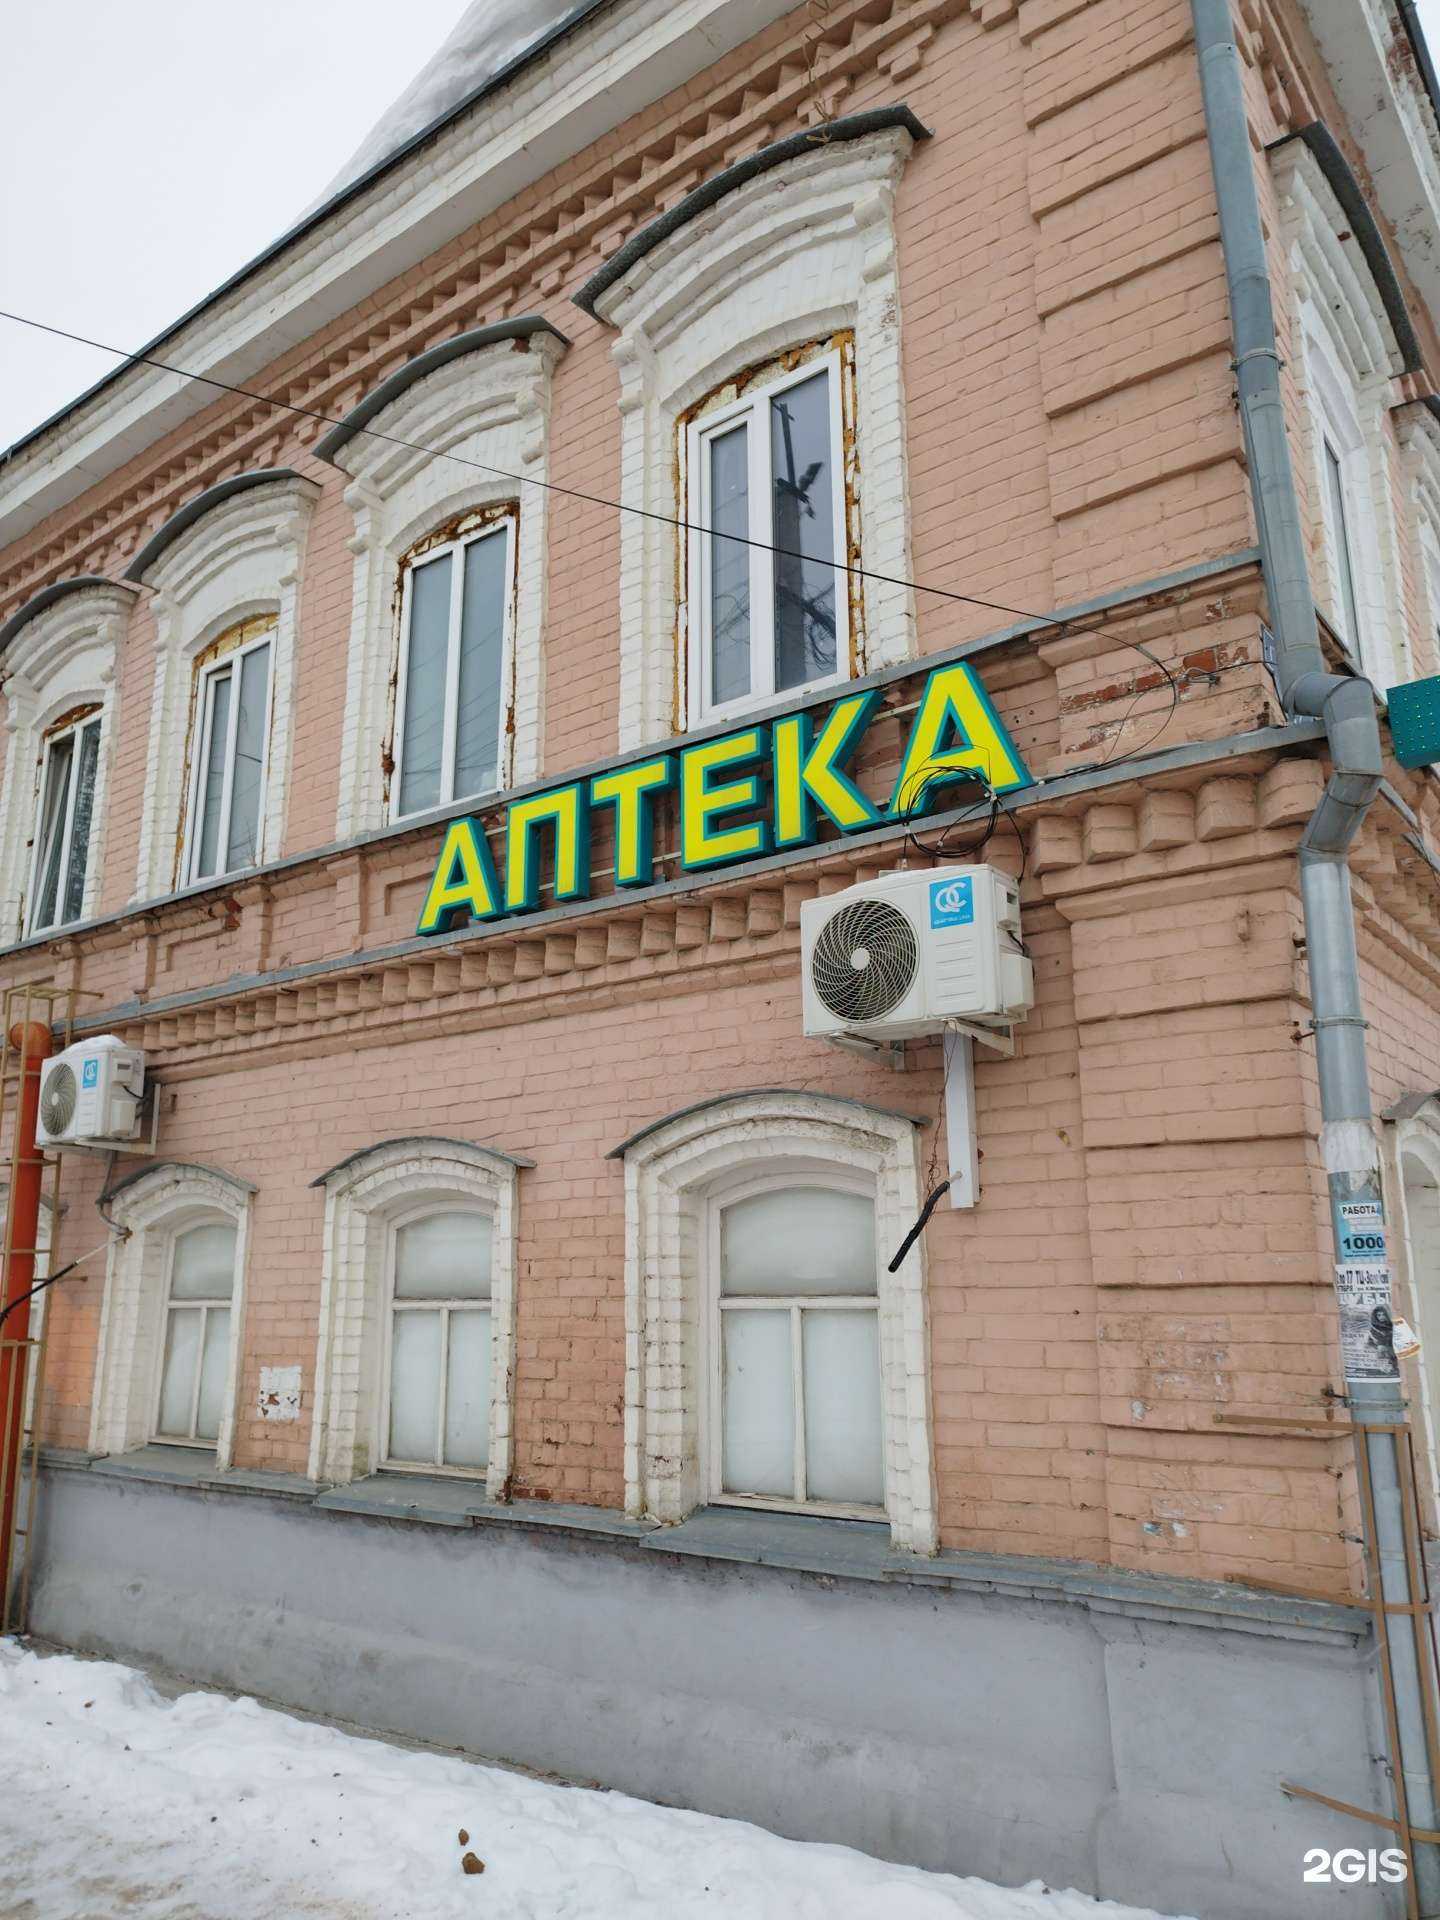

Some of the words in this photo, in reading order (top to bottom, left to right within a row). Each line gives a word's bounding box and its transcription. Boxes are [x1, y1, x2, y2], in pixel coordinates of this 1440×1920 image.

[416, 660, 1034, 937] АПТЕКА
[1342, 1205, 1376, 1215] РАБОТА
[1342, 1236, 1384, 1249] 1000
